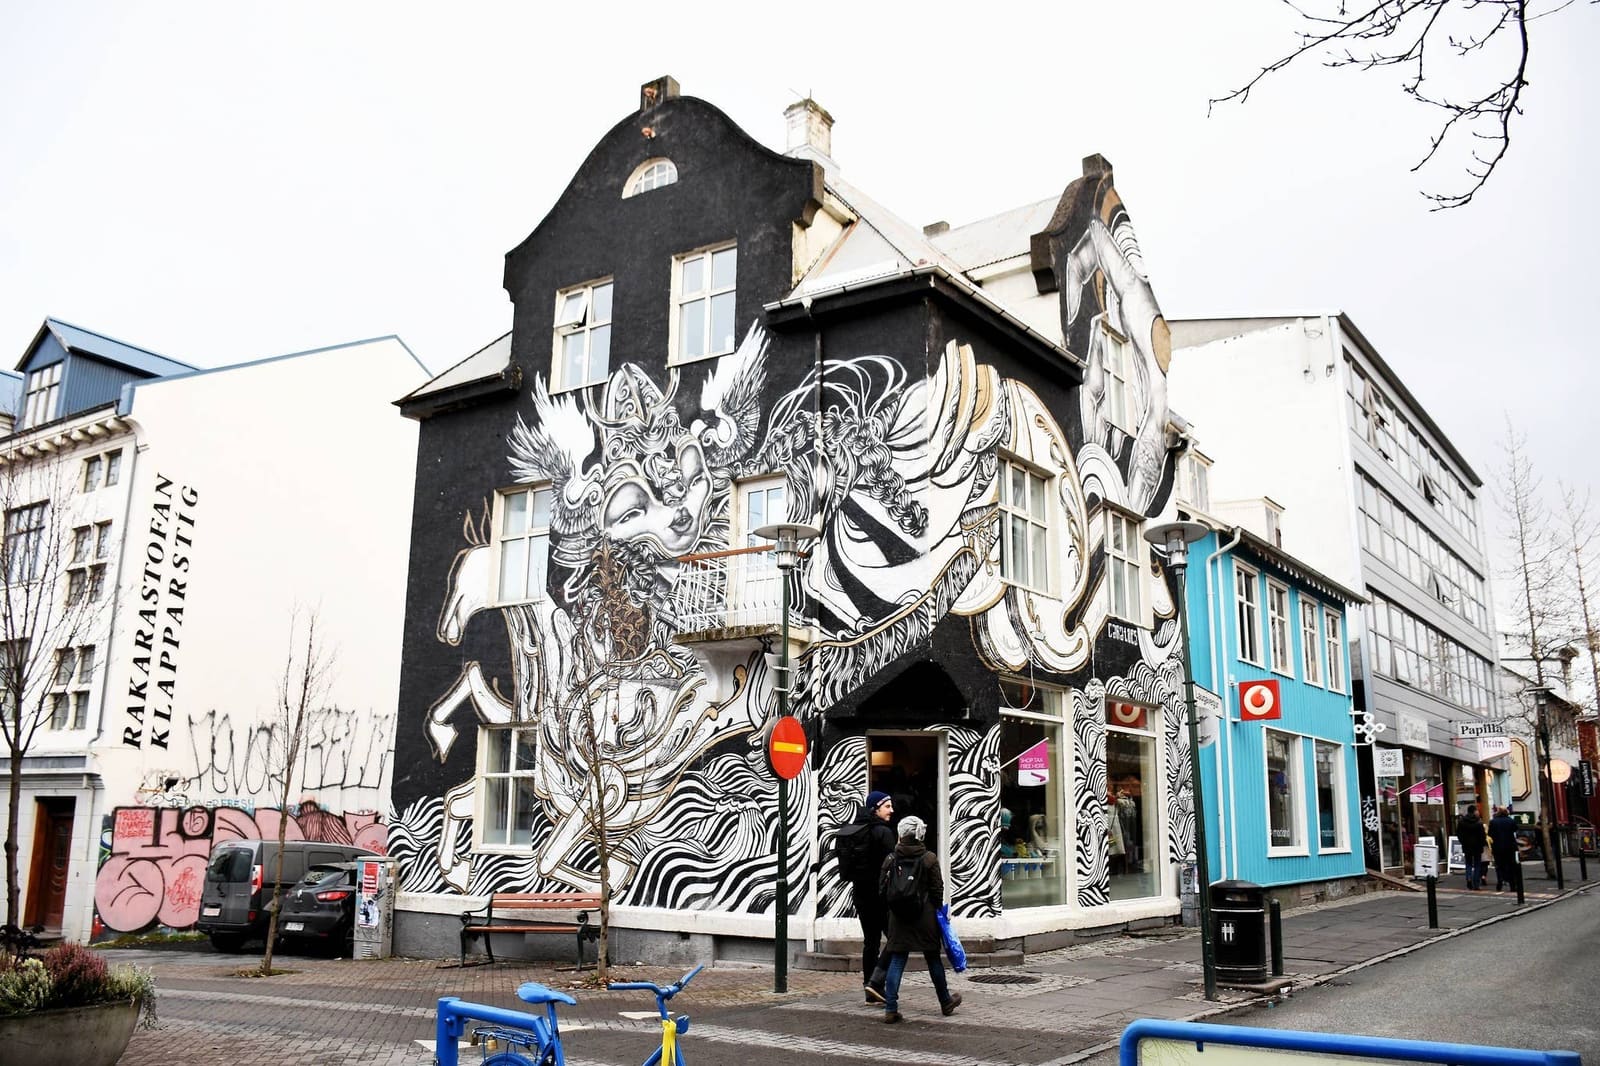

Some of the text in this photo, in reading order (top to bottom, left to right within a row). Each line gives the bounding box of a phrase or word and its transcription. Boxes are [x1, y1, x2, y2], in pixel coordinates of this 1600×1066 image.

[122, 472, 174, 750] RAKARASTOFAN
[150, 484, 199, 750] KLAPPARSTÍG
[1461, 723, 1503, 736] Papilla
